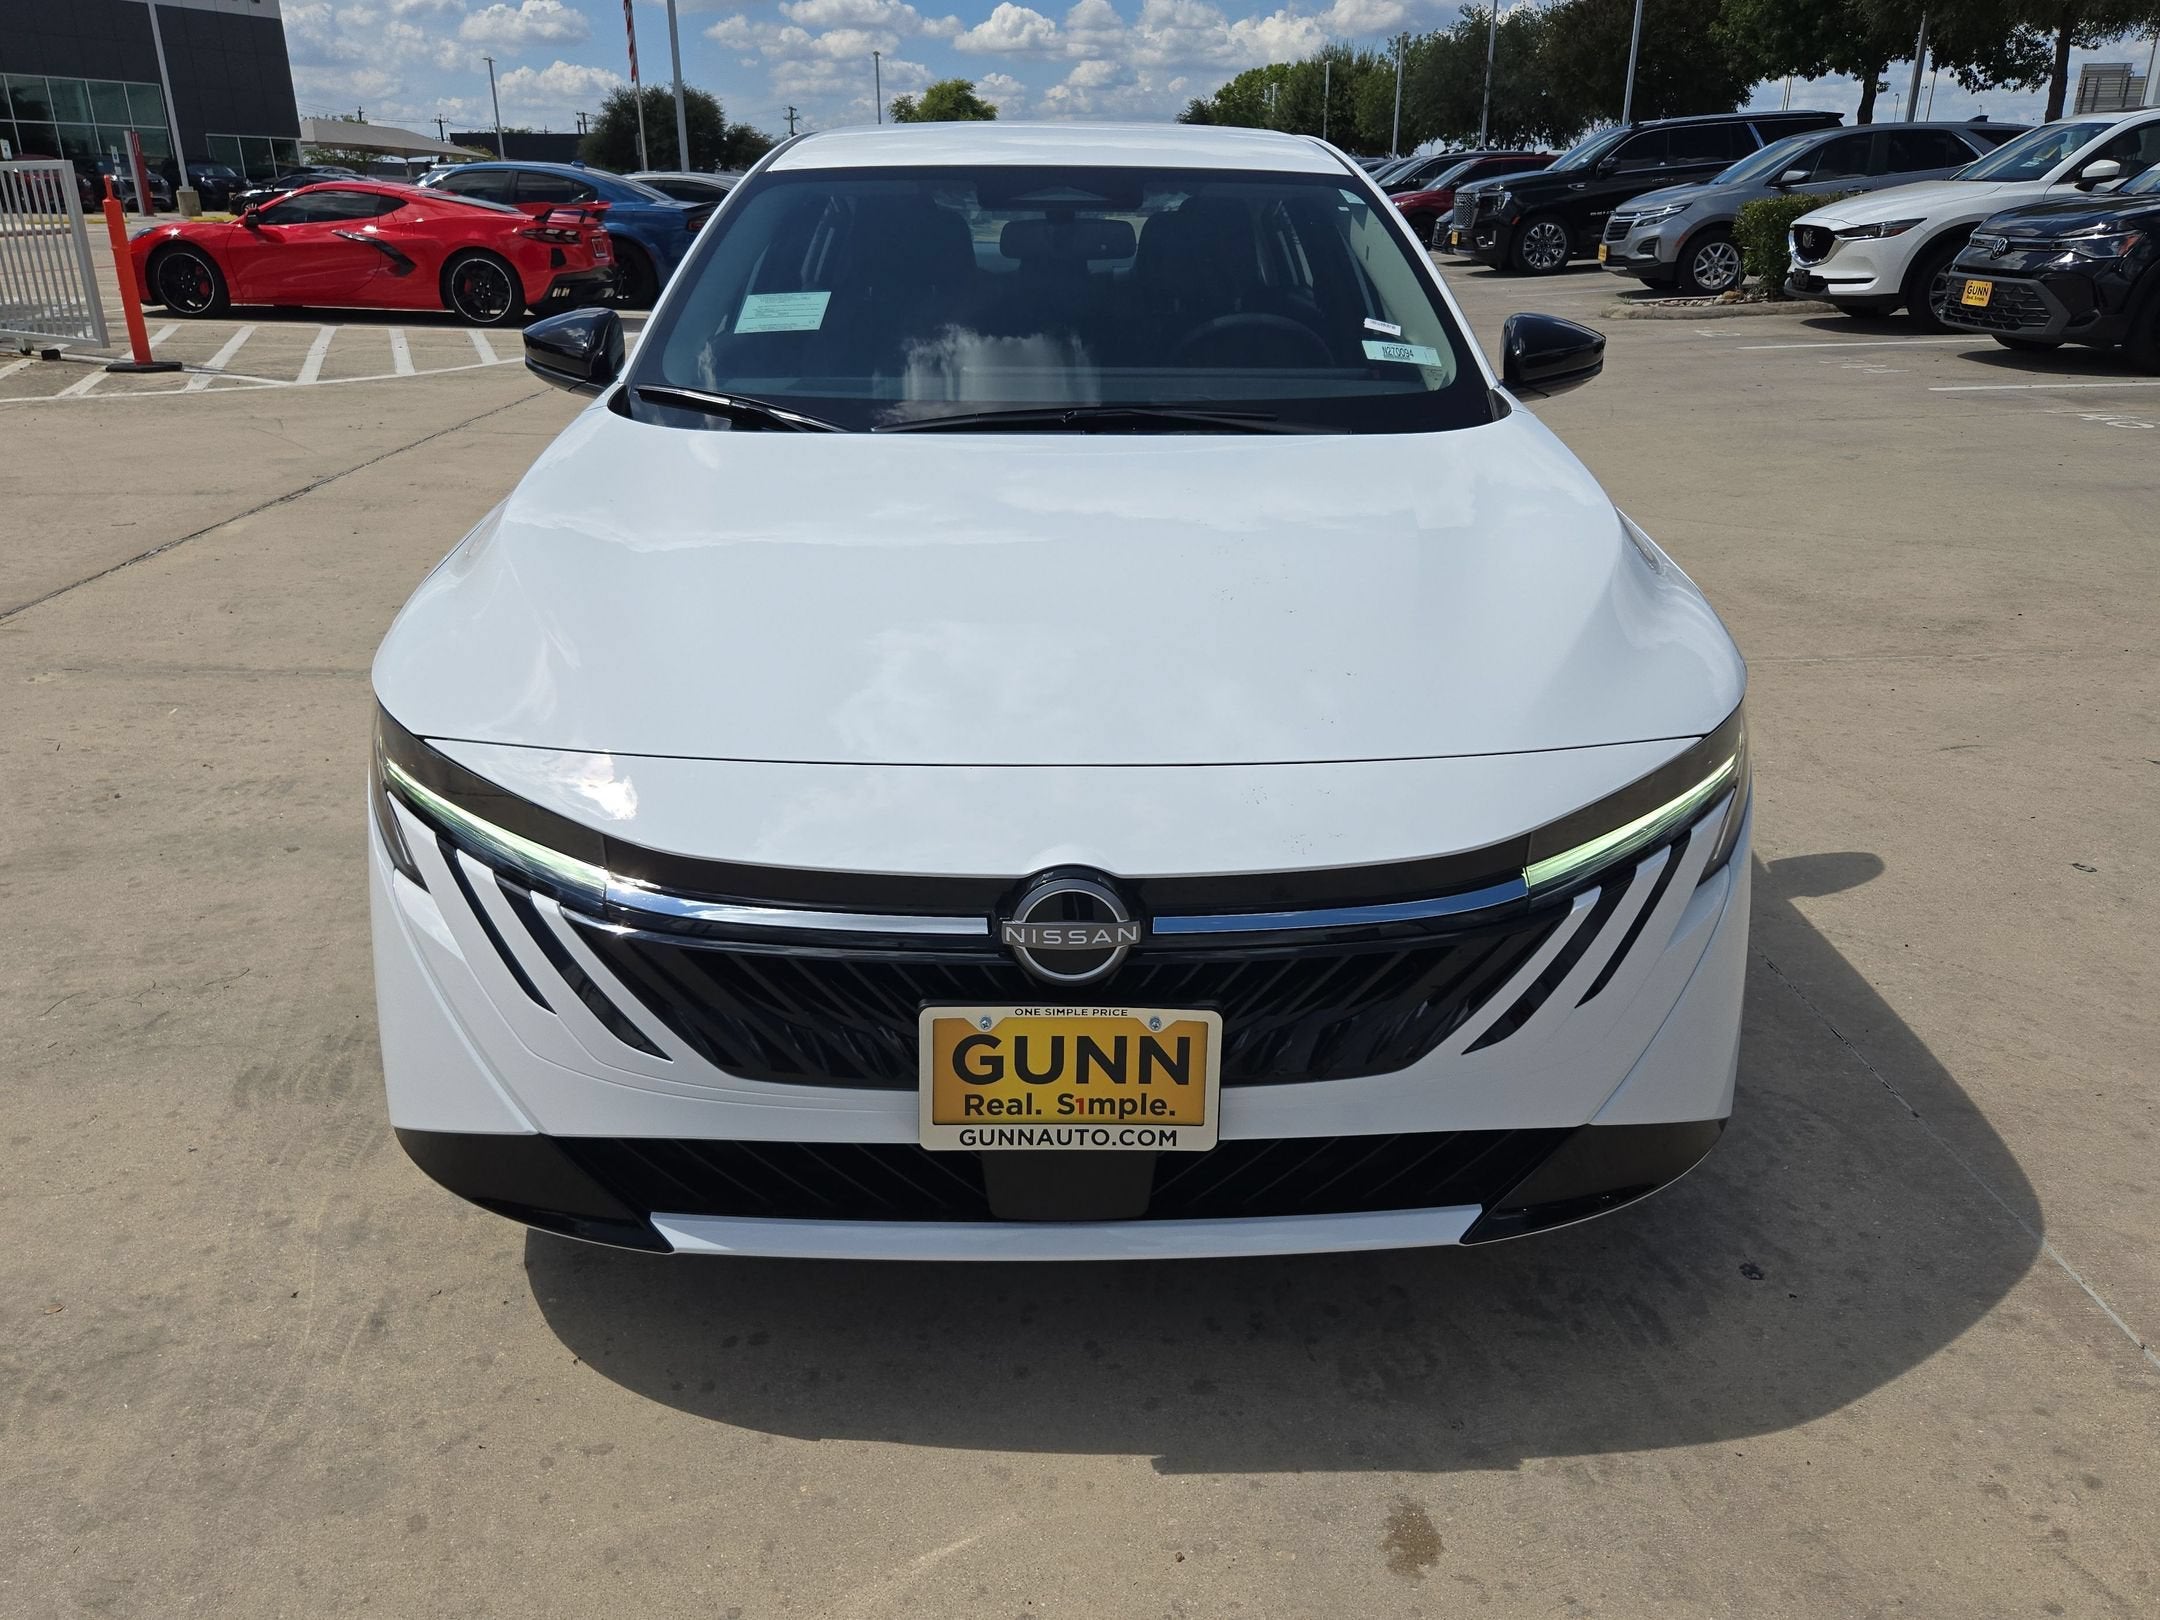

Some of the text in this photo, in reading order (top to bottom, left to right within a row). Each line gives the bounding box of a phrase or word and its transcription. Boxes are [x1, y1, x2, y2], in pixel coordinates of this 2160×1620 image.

[1967, 285, 1988, 296] GUNN
[1005, 926, 1137, 944] NISSAN
[1014, 1008, 1128, 1017] ONE SIMPLE PRICE
[952, 1034, 1191, 1086] GUNN
[964, 1093, 1042, 1116] Real.
[959, 1129, 1178, 1147] GUNNAUTO.COM
